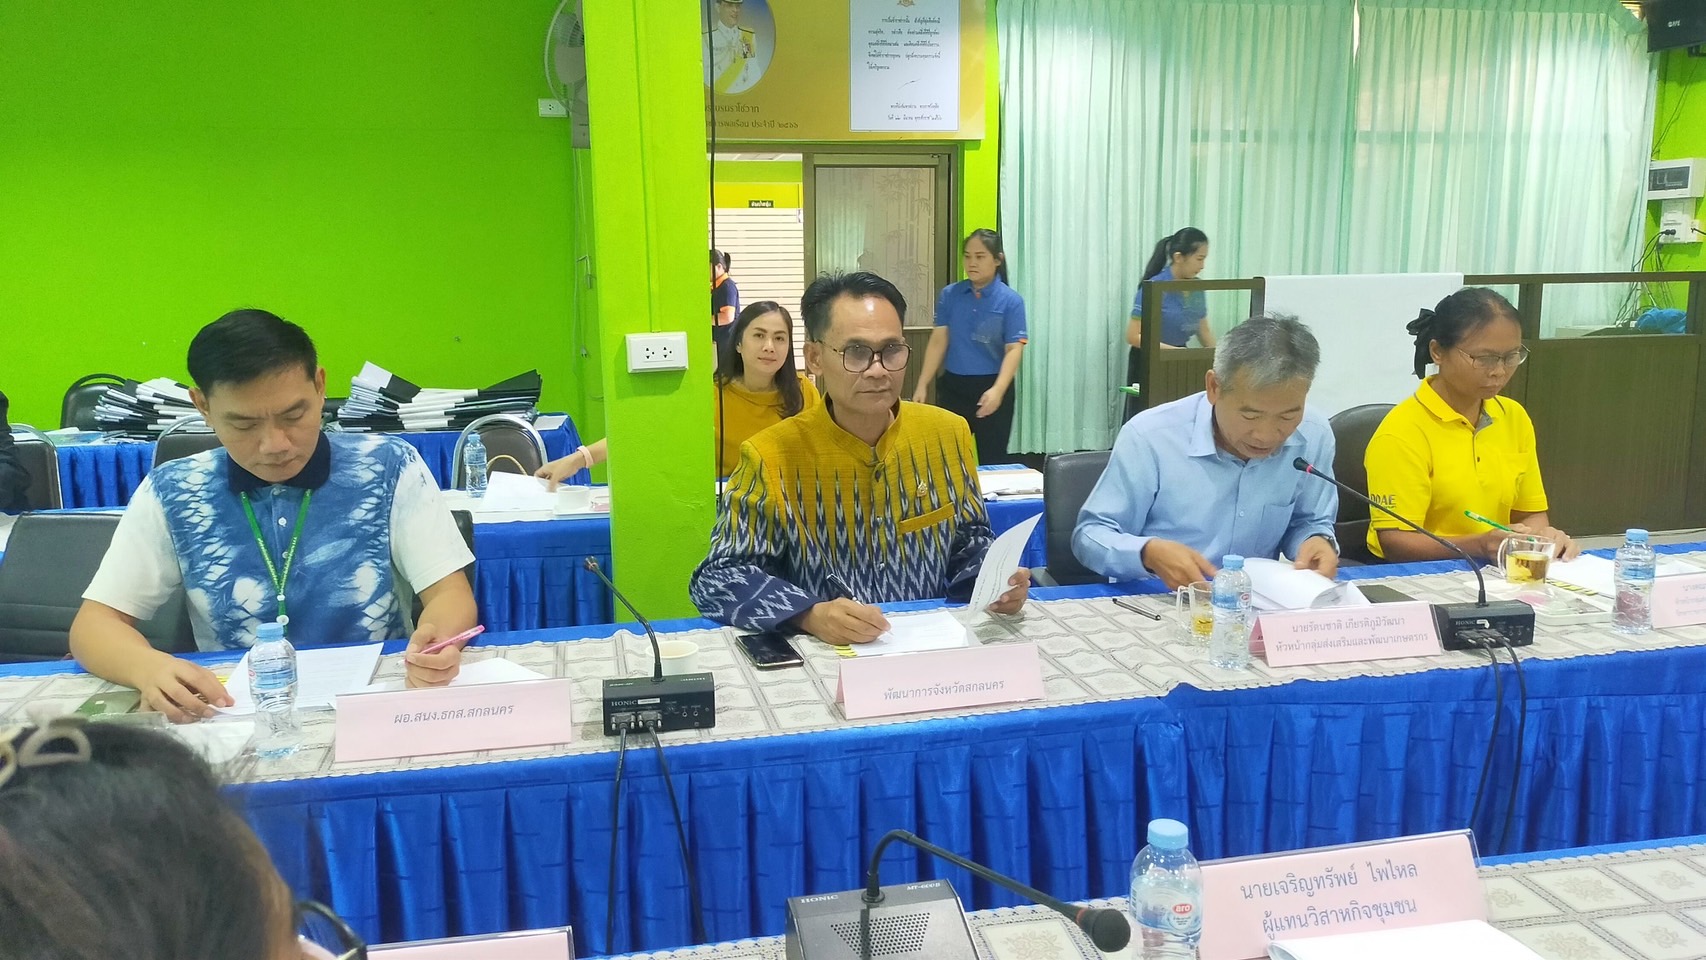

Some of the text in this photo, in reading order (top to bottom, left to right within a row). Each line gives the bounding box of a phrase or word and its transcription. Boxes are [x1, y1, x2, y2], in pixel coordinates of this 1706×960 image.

[883, 679, 1005, 700] พัฒนาการจังหวัดสกลนคร
[1240, 858, 1418, 900] นายเจริญทรัพย์ ไพไหล
[800, 894, 839, 904] HONIC
[1175, 904, 1191, 913] aro
[1262, 898, 1418, 941] ผู้แทนวิสาหกิจชุมชน
